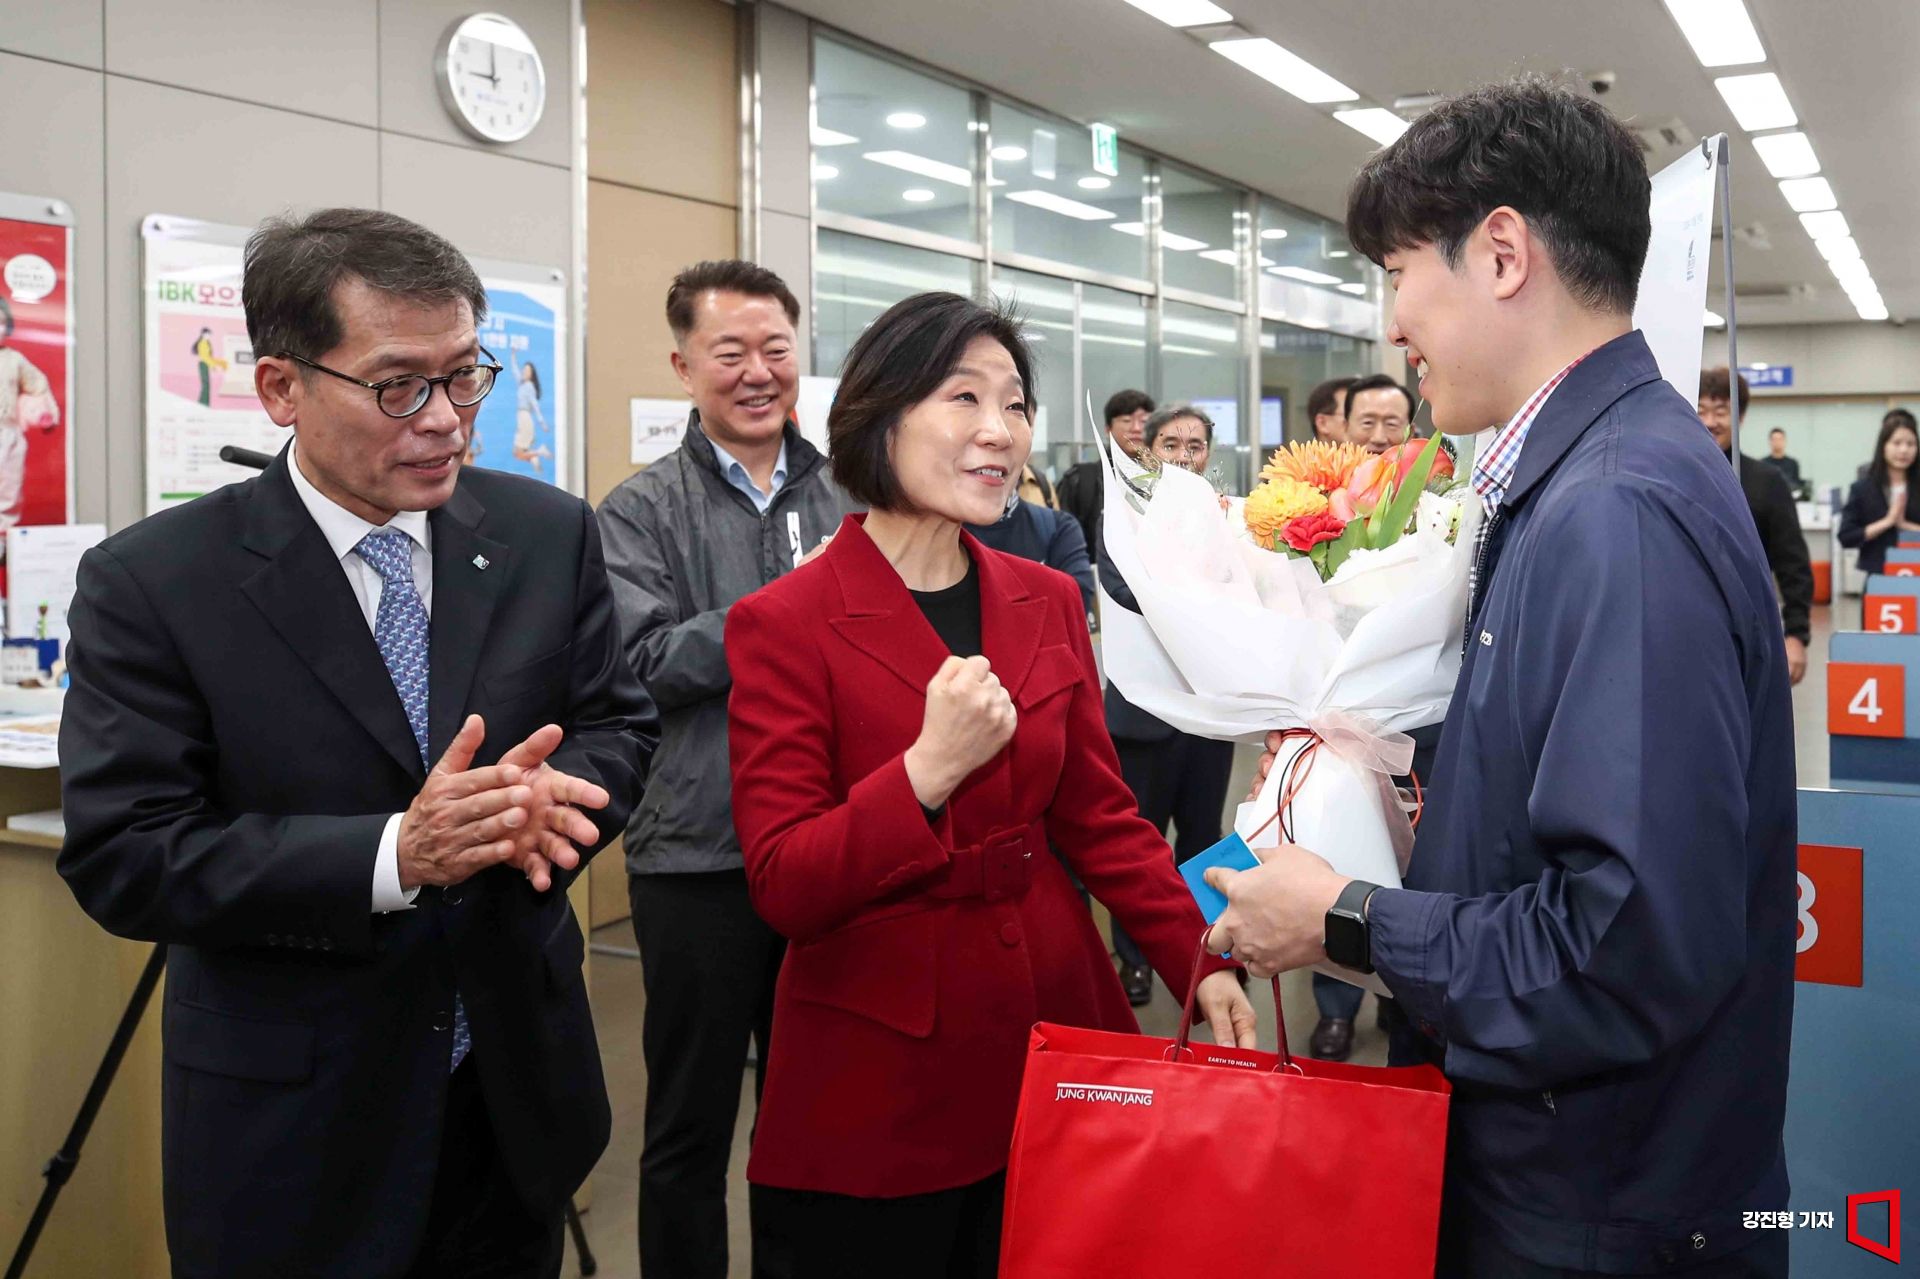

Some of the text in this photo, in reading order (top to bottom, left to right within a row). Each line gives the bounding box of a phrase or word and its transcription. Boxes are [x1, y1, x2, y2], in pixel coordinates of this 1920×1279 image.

[1880, 603, 1903, 634] 5
[1848, 678, 1883, 723] 4
[1208, 1056, 1227, 1064] EARTH
[1235, 1060, 1257, 1068] HEALTH
[1055, 1088, 1152, 1106] JUNG KWAN JANG
